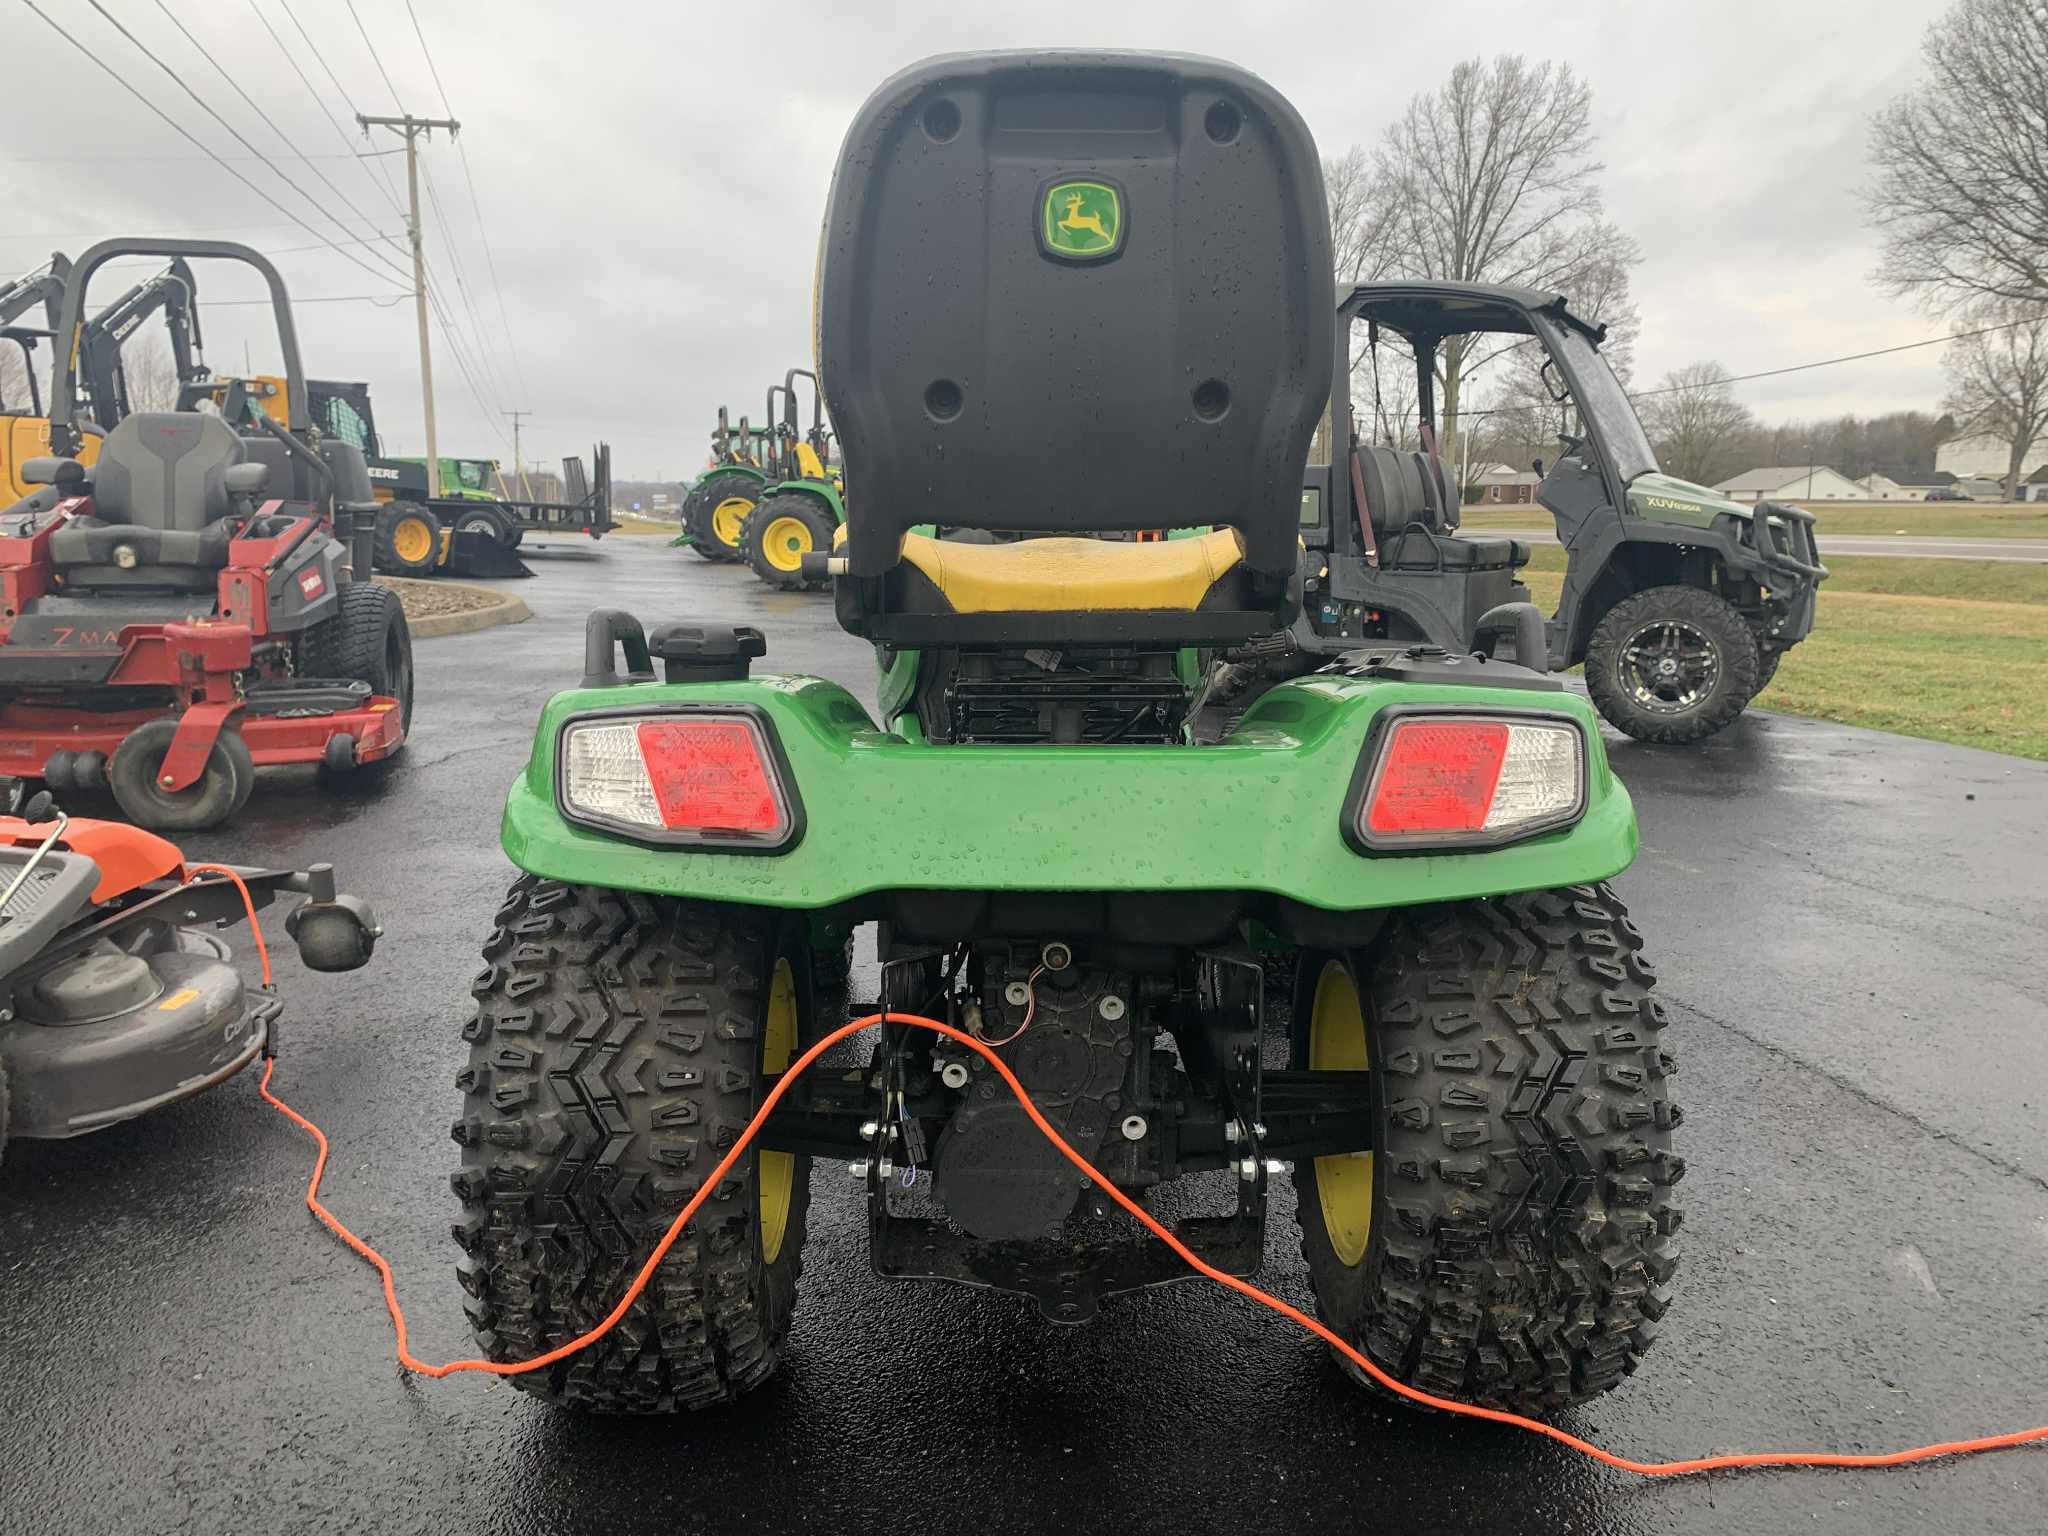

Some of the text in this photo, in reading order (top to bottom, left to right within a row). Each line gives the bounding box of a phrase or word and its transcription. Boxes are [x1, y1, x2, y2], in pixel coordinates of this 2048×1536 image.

[367, 467, 400, 480] EERE
[50, 627, 119, 647] Z MA
